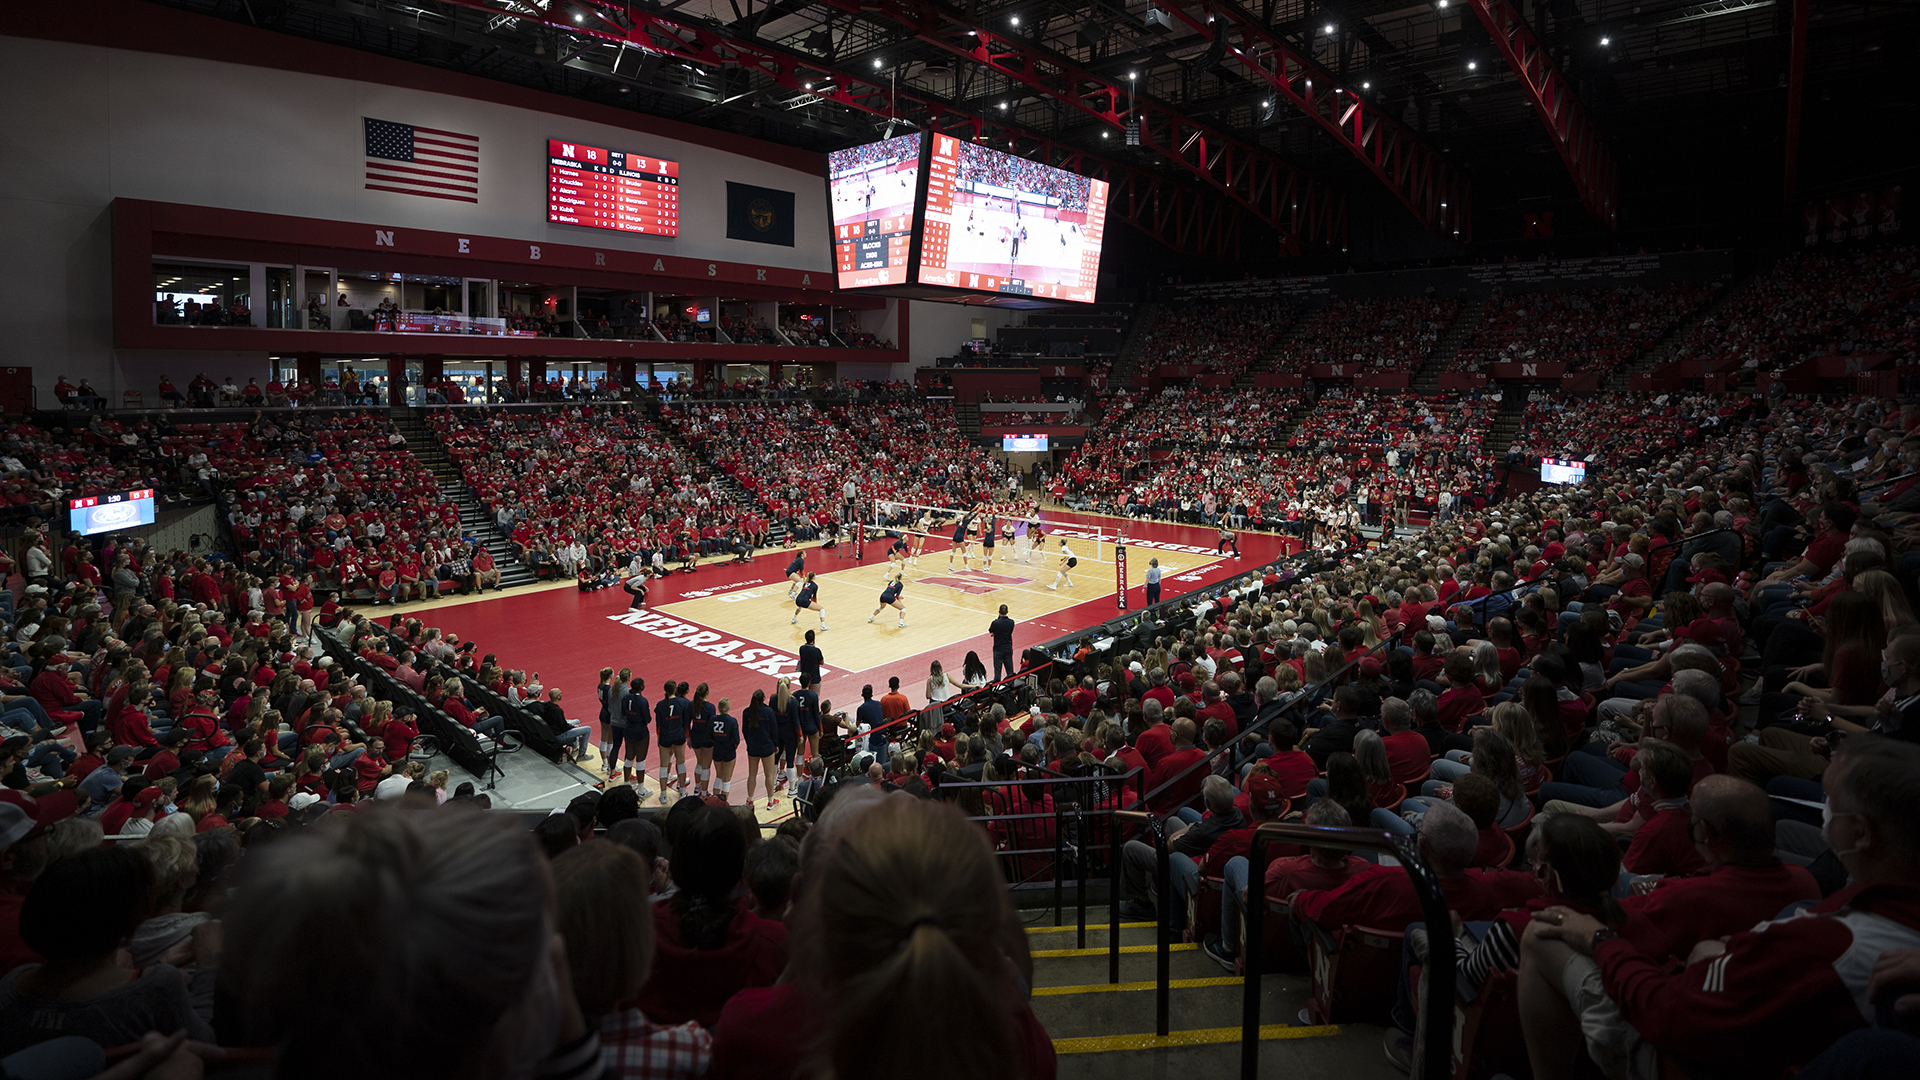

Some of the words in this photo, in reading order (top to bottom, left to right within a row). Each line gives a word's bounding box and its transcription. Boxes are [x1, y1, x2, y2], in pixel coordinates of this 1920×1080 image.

[563, 144, 574, 157] N
[587, 150, 596, 159] 18
[940, 137, 953, 156] N
[552, 159, 582, 168] NEBRASKA
[637, 159, 646, 168] 13
[659, 161, 667, 174] I
[619, 170, 640, 178] ILLINOIS
[884, 220, 892, 230] 13
[840, 226, 848, 238] N
[853, 225, 860, 234] 18
[855, 278, 879, 286] Ameritas
[924, 274, 946, 283] Ameritas
[969, 274, 979, 287] N
[988, 278, 994, 287] 18
[1038, 285, 1044, 293] 13
[1055, 367, 1065, 376] N
[1178, 366, 1188, 375] N
[1331, 365, 1343, 376] N
[1522, 364, 1537, 376] N
[1845, 358, 1863, 374] N
[713, 721, 724, 733] 22
